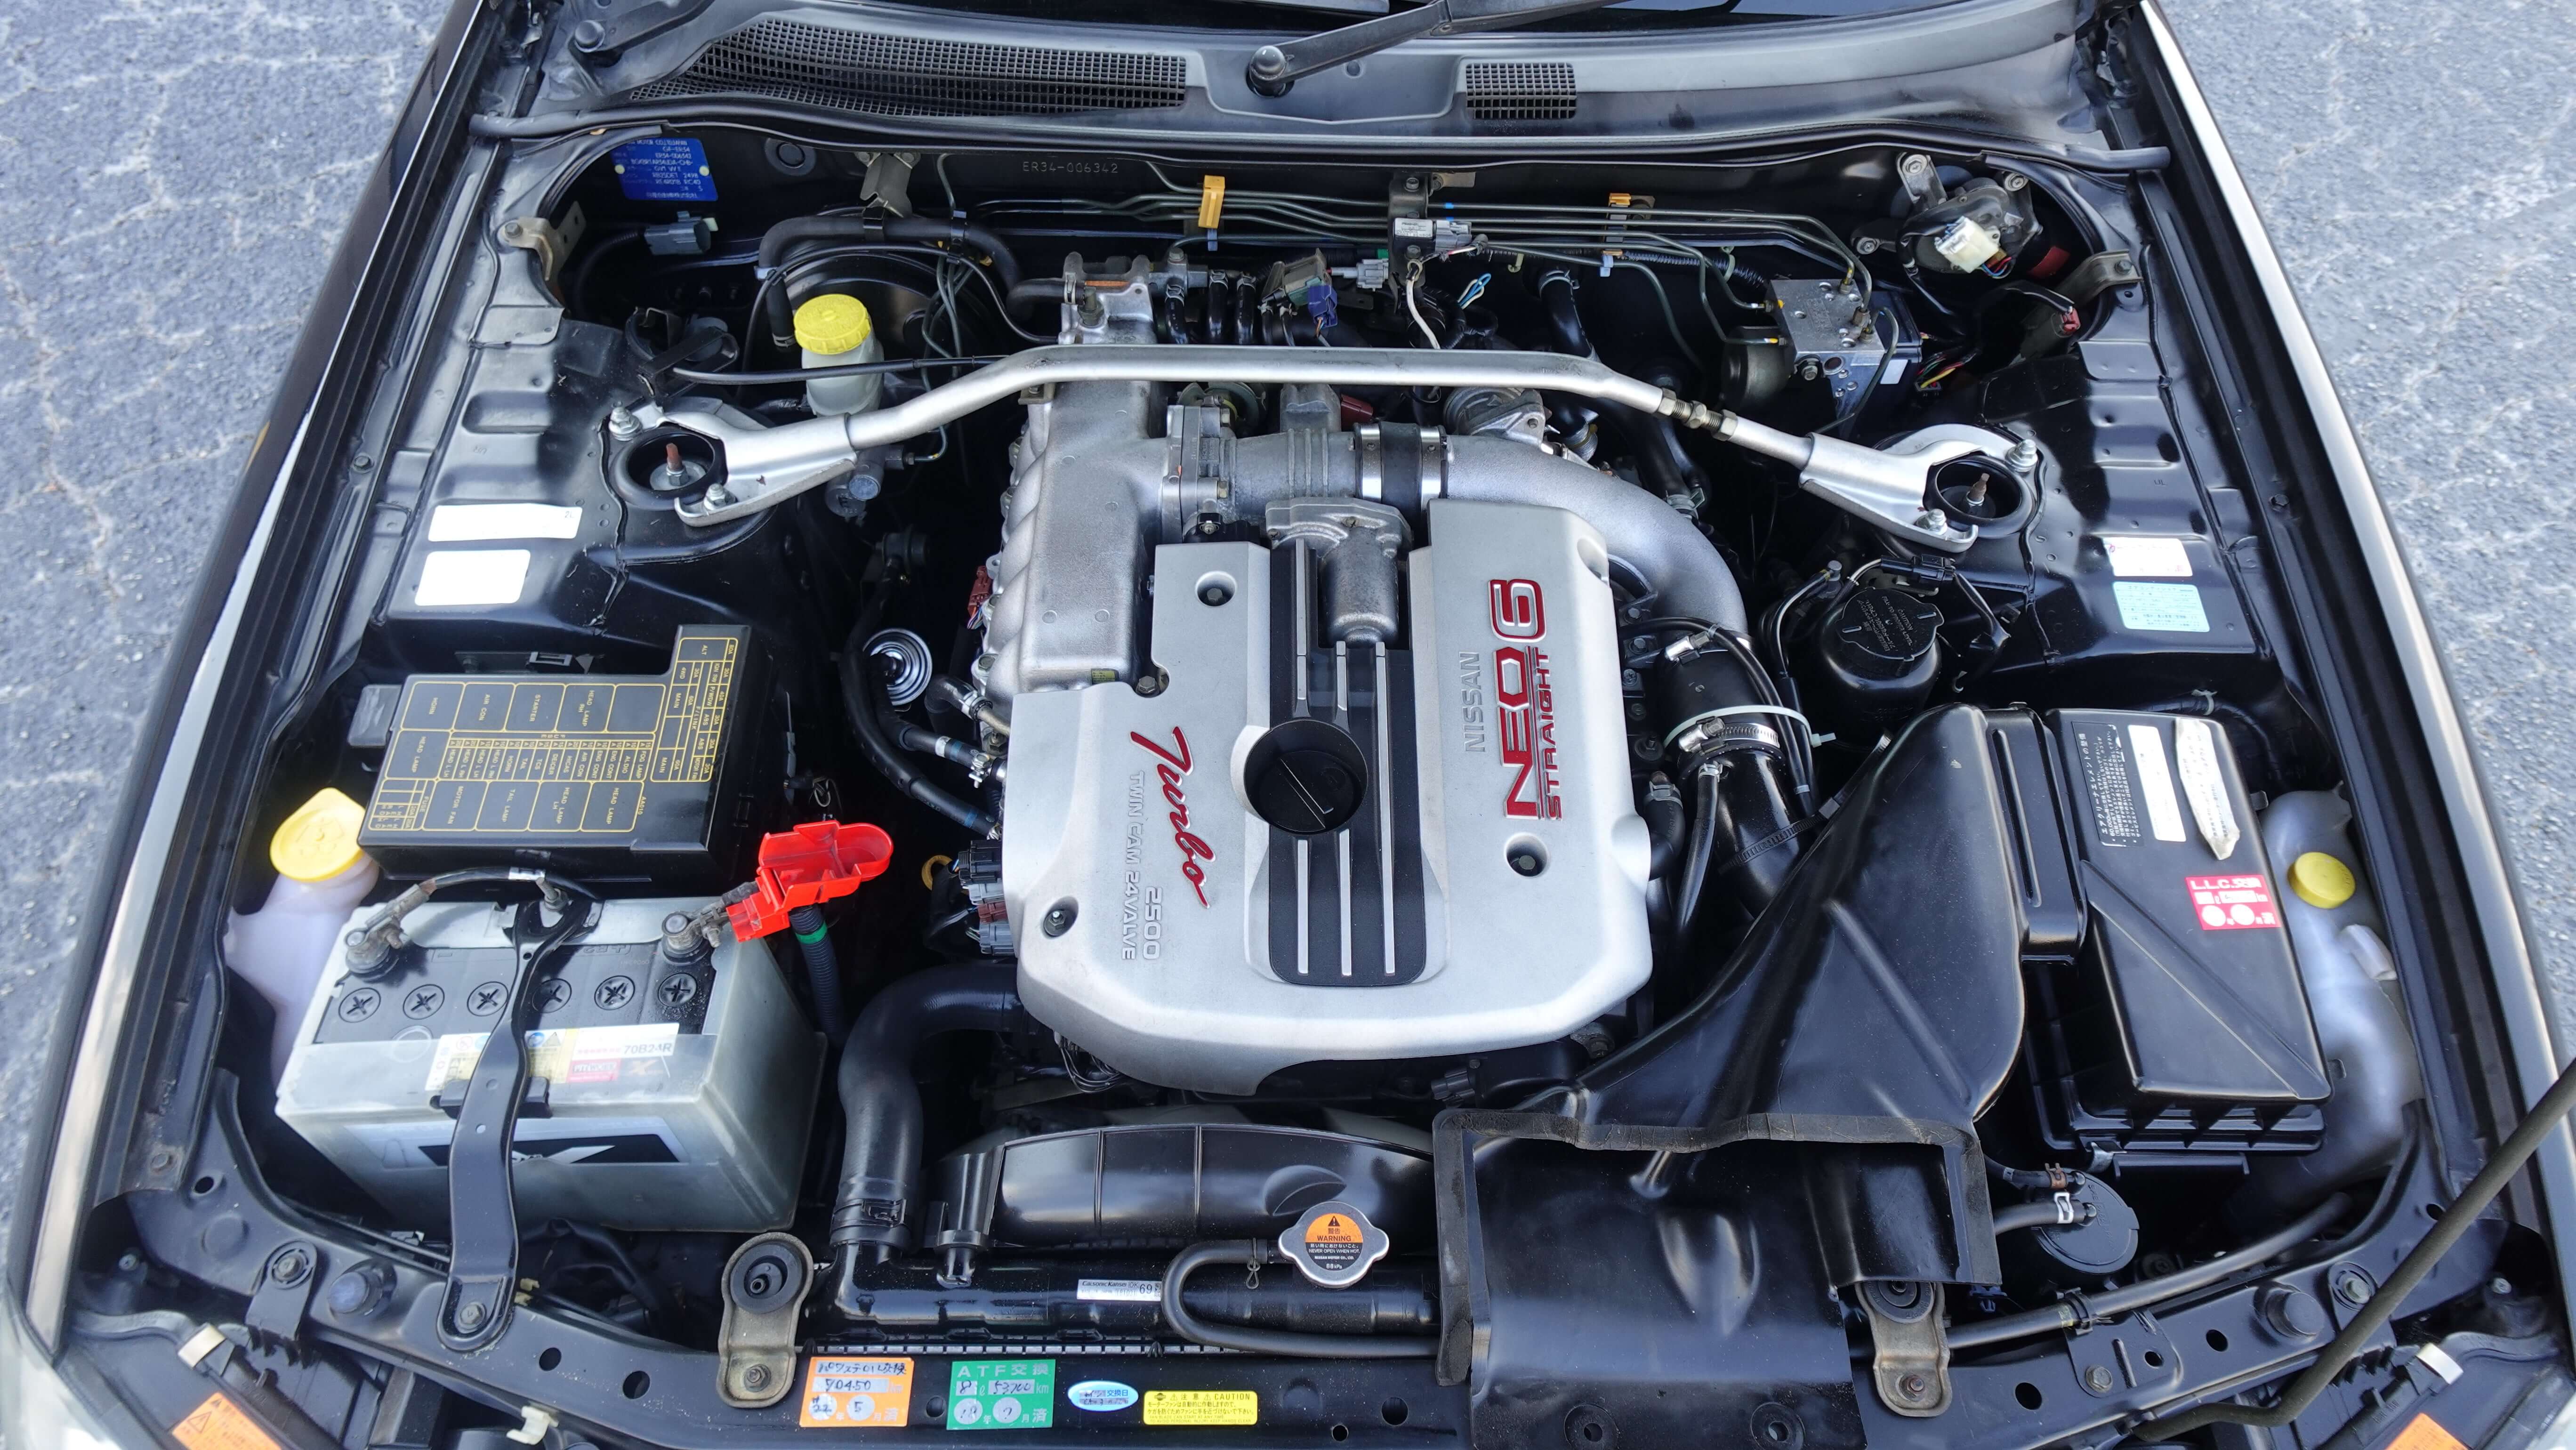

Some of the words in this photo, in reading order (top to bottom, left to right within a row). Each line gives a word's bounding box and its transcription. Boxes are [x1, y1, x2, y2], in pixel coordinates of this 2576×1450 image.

[1023, 161, 1118, 173] ER34-006342
[1488, 579, 1547, 643] 6
[1898, 609, 1913, 630] CAUTION
[711, 674, 718, 682] SW
[706, 687, 714, 706] P/WDW
[1459, 651, 1486, 752] NISSAN
[429, 697, 437, 715] HORN
[529, 694, 540, 722] STARTER
[579, 704, 584, 713] RH
[691, 706, 700, 730] F/LINK
[1493, 646, 1539, 819] NEO
[1534, 647, 1563, 821] STRAIGHT
[416, 736, 426, 753] HEAD
[411, 756, 420, 773] LAMP
[505, 756, 514, 772] HORN
[520, 758, 528, 769] TAIL
[548, 754, 558, 775] DEICER
[564, 756, 572, 773] HICAS
[592, 764, 600, 779] CONT
[606, 764, 614, 779] CONT
[659, 757, 667, 773] MAIN
[455, 786, 464, 808] MOTOR
[507, 789, 515, 802] TAIL
[561, 787, 570, 804] HEAD
[611, 788, 620, 805] HEAD
[1128, 771, 1144, 817] TWIN
[419, 796, 429, 813] FUSE
[553, 801, 559, 810] LH
[637, 796, 646, 815] AA010
[448, 811, 456, 825] FAN
[556, 807, 564, 824] LAMP
[606, 807, 614, 825] LAMP
[1130, 726, 1216, 909] Turbo
[1126, 822, 1143, 864] CAM
[1122, 871, 1139, 960] 24VALVE
[1143, 886, 1162, 960] 2500
[1139, 1284, 1152, 1294] 69
[1036, 1383, 1049, 1394] km
[1021, 1414, 1029, 1423] 月
